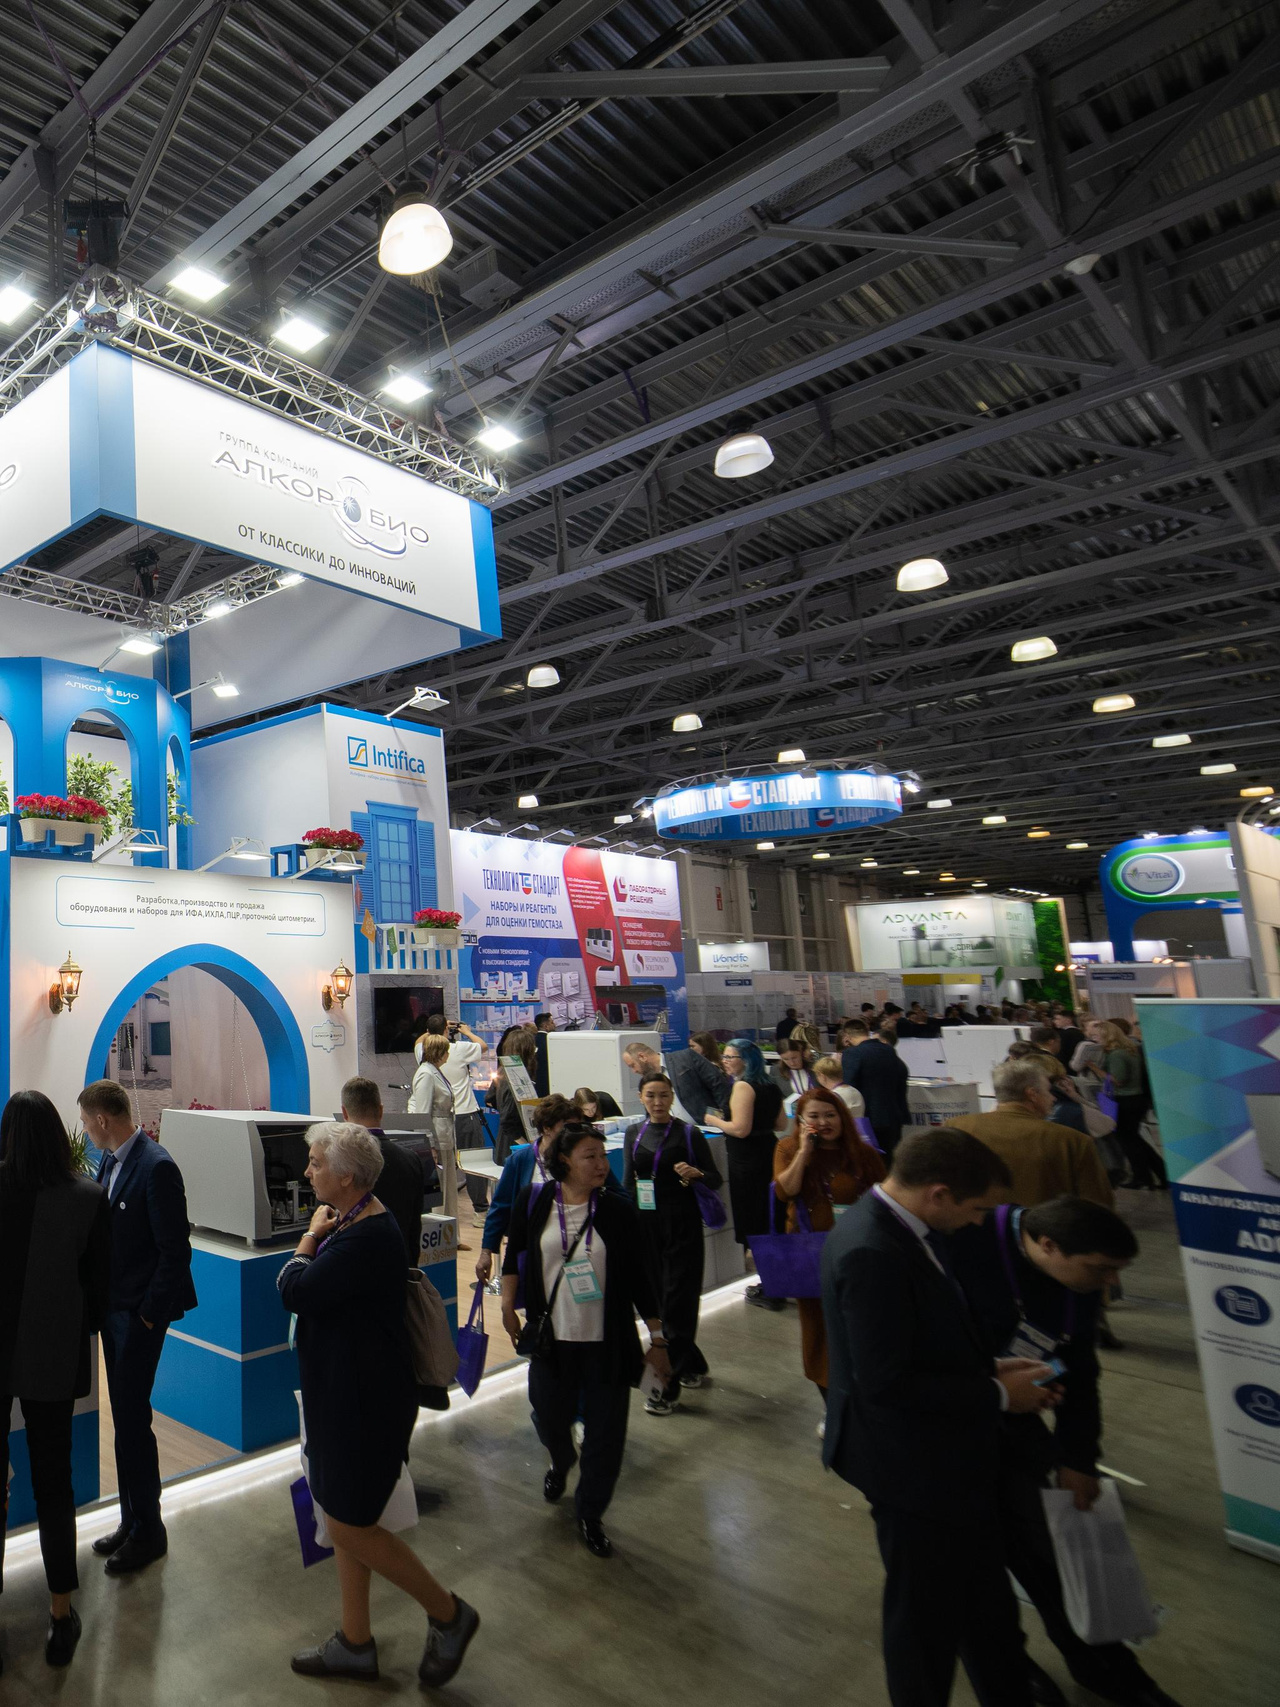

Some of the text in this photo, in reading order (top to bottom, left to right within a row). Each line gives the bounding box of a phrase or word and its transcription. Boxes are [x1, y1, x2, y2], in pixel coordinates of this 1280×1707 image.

[219, 431, 319, 479] ГРУППА КОМПАНИЙ
[215, 451, 429, 545] АЛКОР БИО
[237, 524, 417, 596] ОТ КЛАССИКИ ДО ИННОВАЦИЙ
[65, 680, 139, 700] АЛКОР БИО
[372, 744, 426, 774] Intifica
[751, 774, 821, 806] СТАНДАРТ
[740, 808, 810, 833] ТЕХНОЛОГИЯ
[482, 868, 520, 892] ТЕХНОЛОГИЯ
[532, 874, 561, 898] СТАНДАРТ
[69, 902, 128, 914] оборудования
[137, 907, 168, 917] наборов
[236, 902, 265, 911] продажа
[490, 900, 558, 915] НАБОРЫ И РЕАГЕНТЫ
[882, 911, 968, 924] ADVANTA
[486, 915, 564, 930] ДЛЯ ОЦЕНКИ ГЕМОСТАЗА
